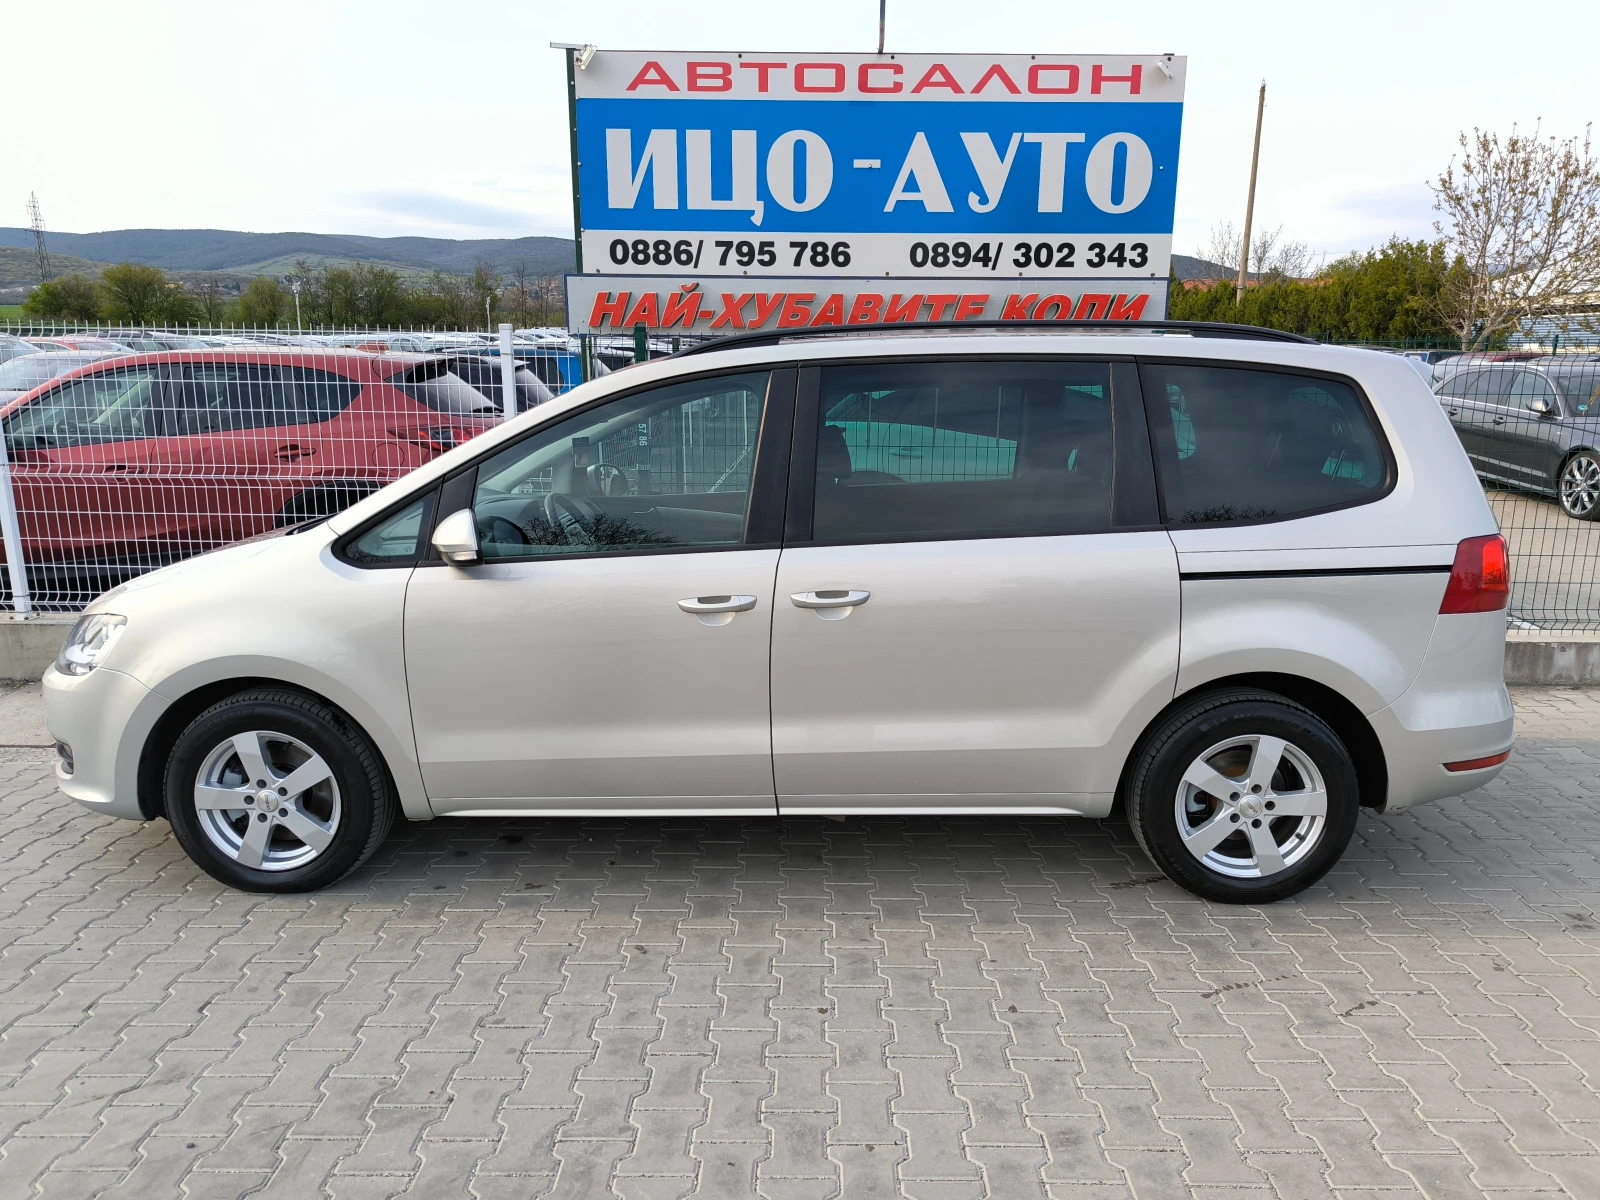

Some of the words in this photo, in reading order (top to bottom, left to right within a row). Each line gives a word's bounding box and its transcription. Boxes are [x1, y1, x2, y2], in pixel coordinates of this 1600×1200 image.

[625, 61, 1142, 95] АВТОСАЛОН
[609, 239, 704, 269] 0886/
[714, 240, 777, 267] 795
[789, 241, 852, 268] 786
[909, 241, 1003, 270] 0894/
[1012, 242, 1076, 268] 302
[1086, 242, 1149, 269] 343
